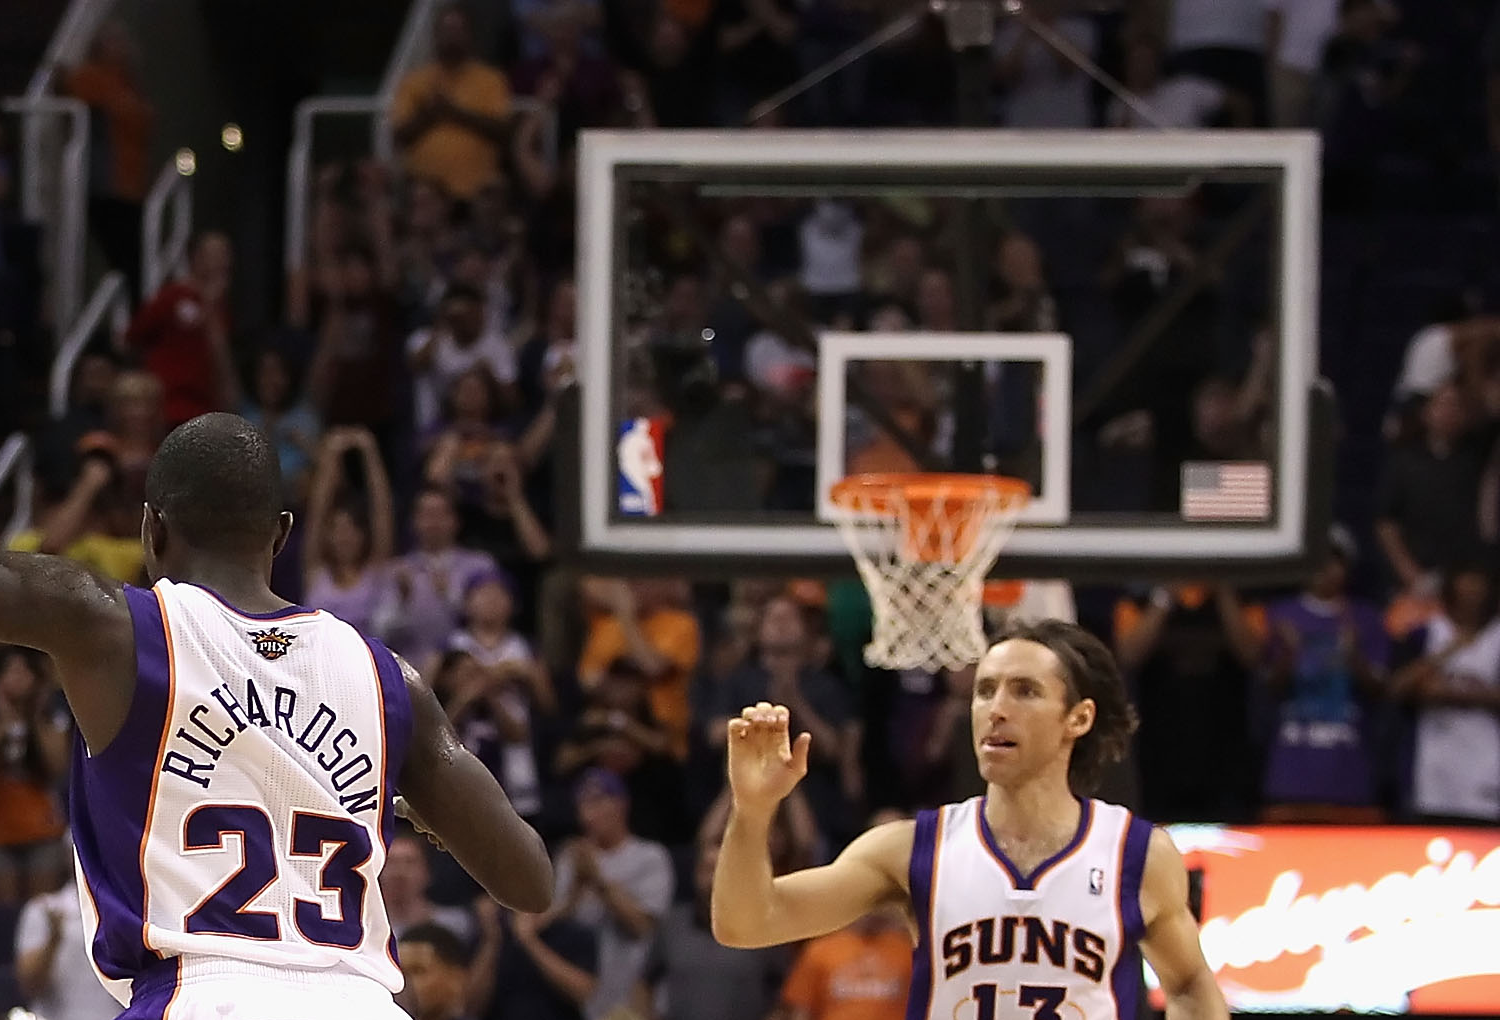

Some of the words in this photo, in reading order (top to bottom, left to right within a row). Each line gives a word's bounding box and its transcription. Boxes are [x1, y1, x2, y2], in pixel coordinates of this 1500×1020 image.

[162, 679, 378, 815] RICHARDSON
[182, 804, 373, 949] 23
[942, 916, 1106, 984] SUNS
